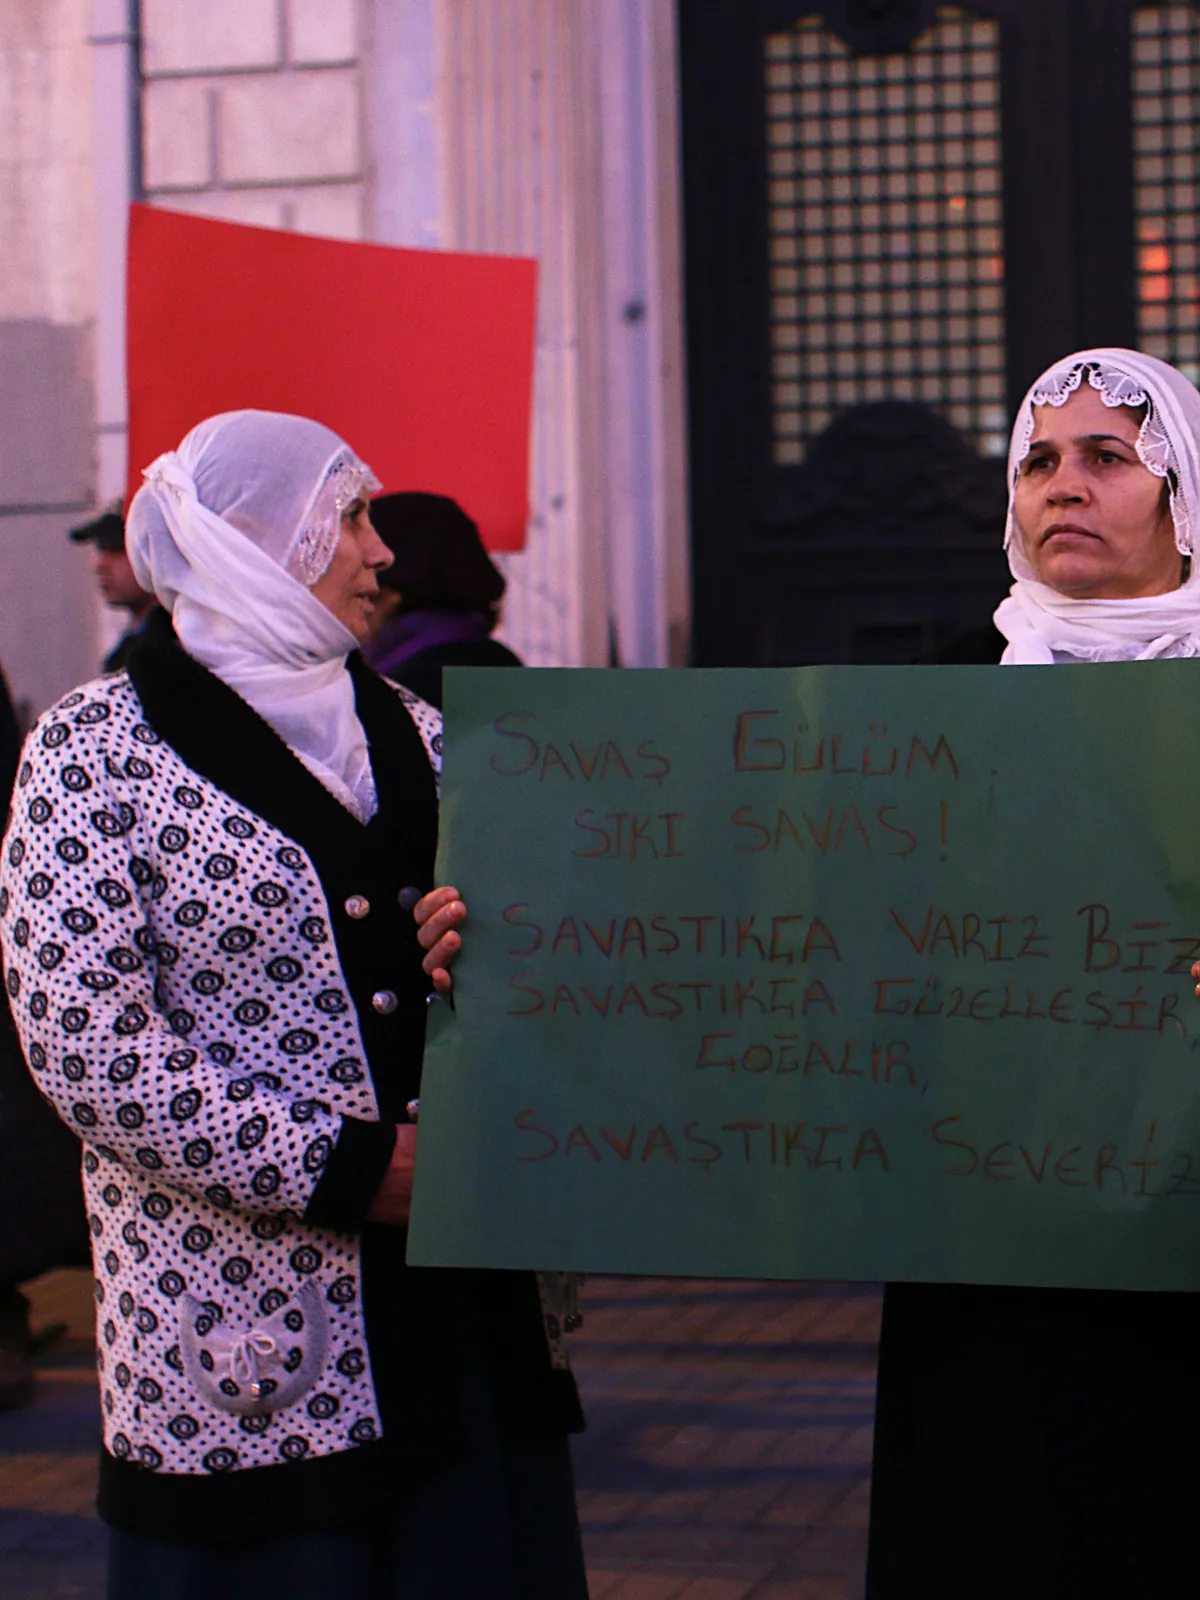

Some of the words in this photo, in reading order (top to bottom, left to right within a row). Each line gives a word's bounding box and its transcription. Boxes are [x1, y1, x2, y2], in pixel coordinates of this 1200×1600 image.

[489, 711, 671, 785] SAVAŞ
[733, 710, 959, 780] GÜLÜM
[890, 905, 1050, 963] VARIZ
